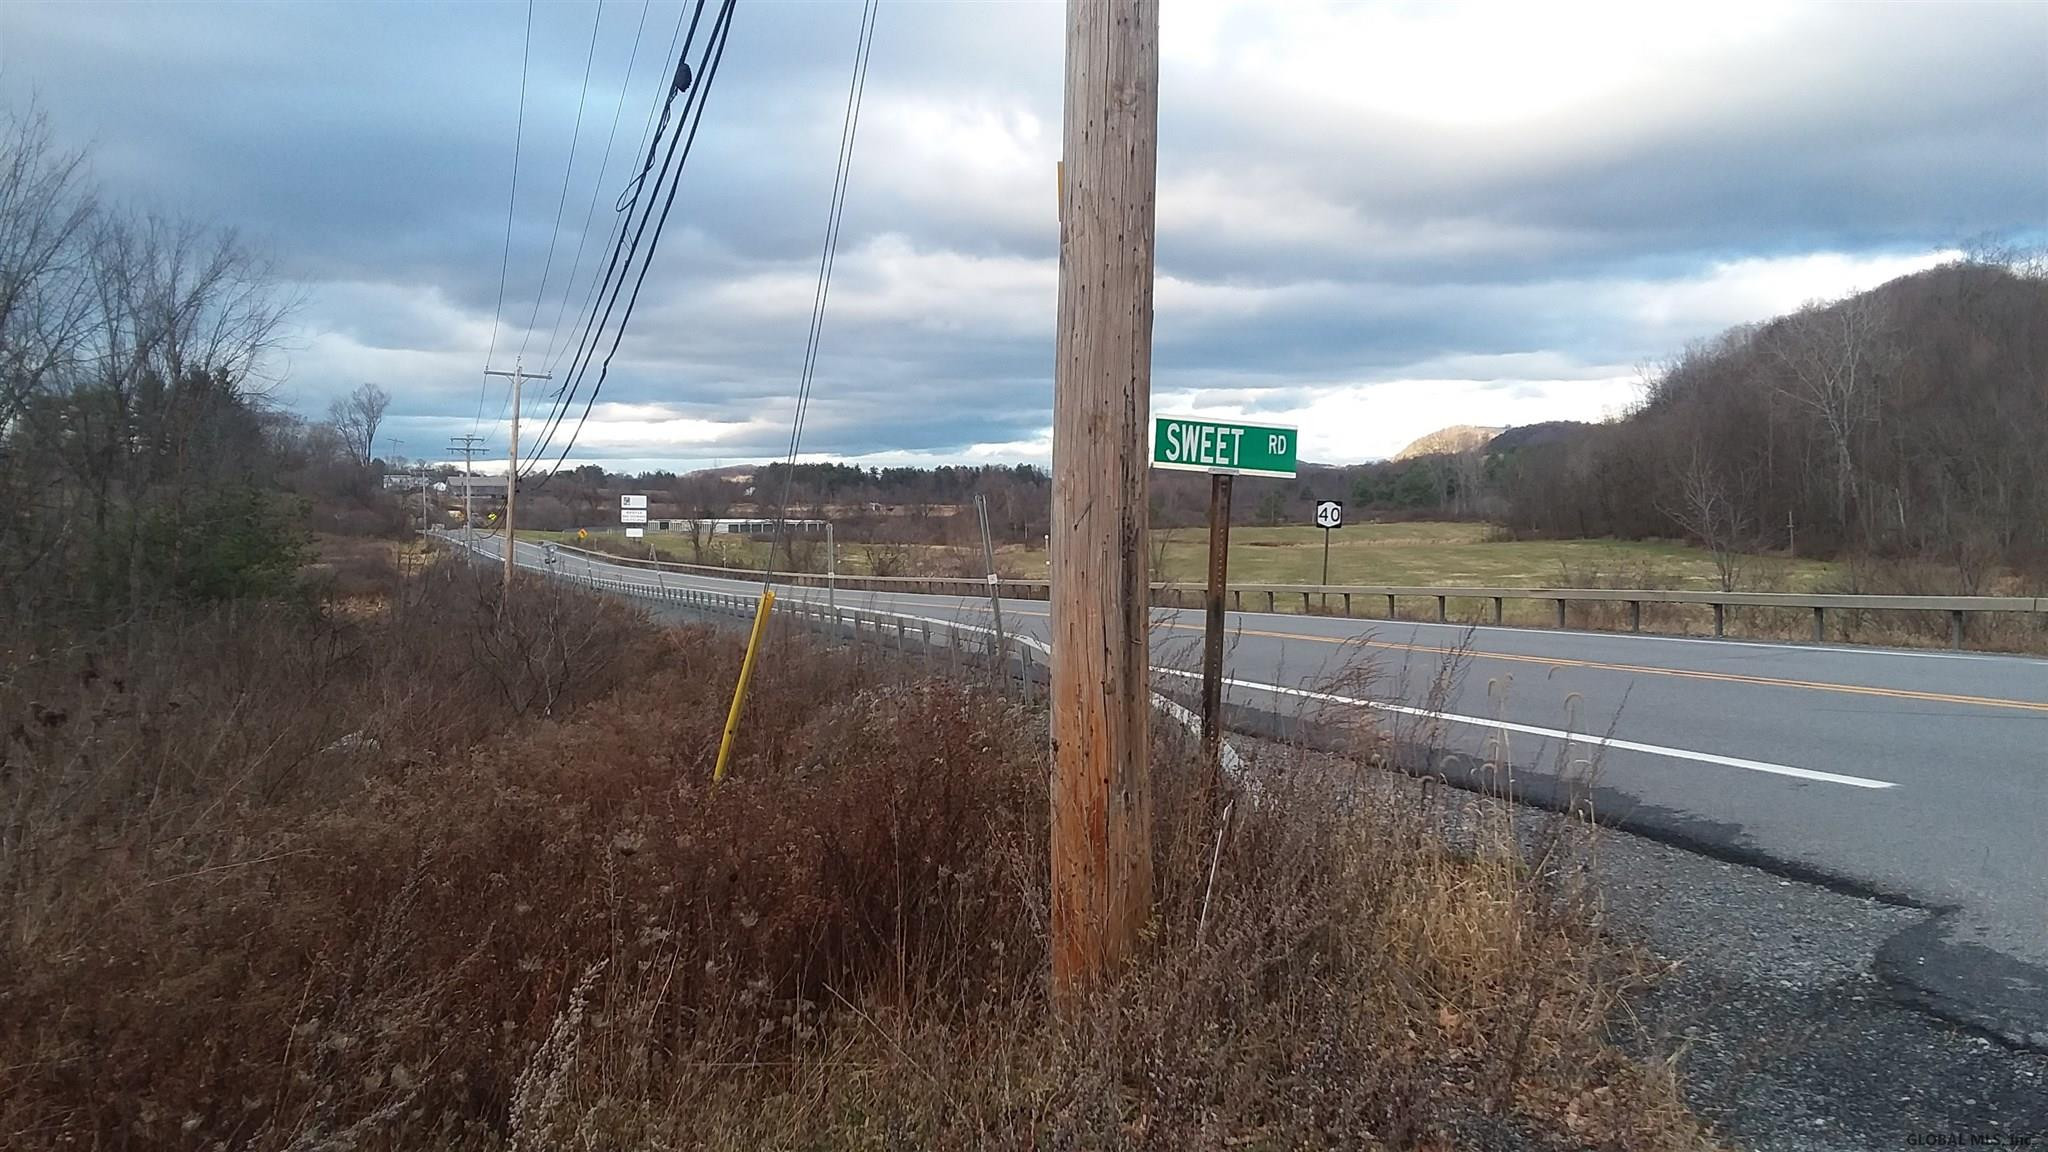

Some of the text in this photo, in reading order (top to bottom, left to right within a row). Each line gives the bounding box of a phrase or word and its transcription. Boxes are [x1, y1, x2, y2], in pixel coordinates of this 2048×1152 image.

[1165, 422, 1287, 466] SWEET RD
[1318, 507, 1340, 522] 40
